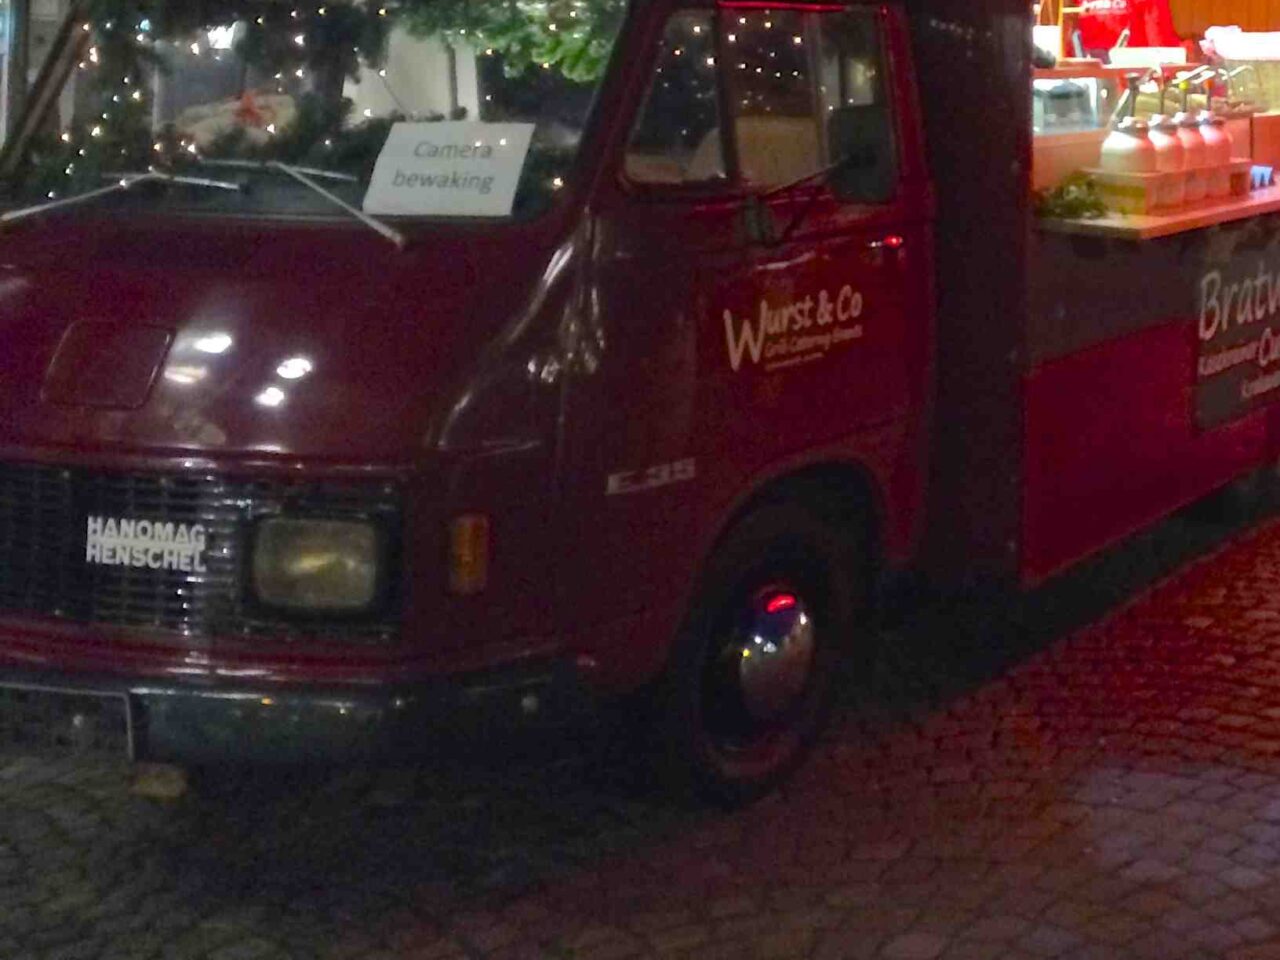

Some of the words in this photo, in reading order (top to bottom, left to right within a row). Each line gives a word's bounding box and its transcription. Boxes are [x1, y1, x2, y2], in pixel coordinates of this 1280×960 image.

[413, 140, 494, 159] Camera
[391, 169, 496, 195] bewaking
[86, 515, 207, 550] HANOMAG
[85, 540, 208, 573] HENSCHEL
